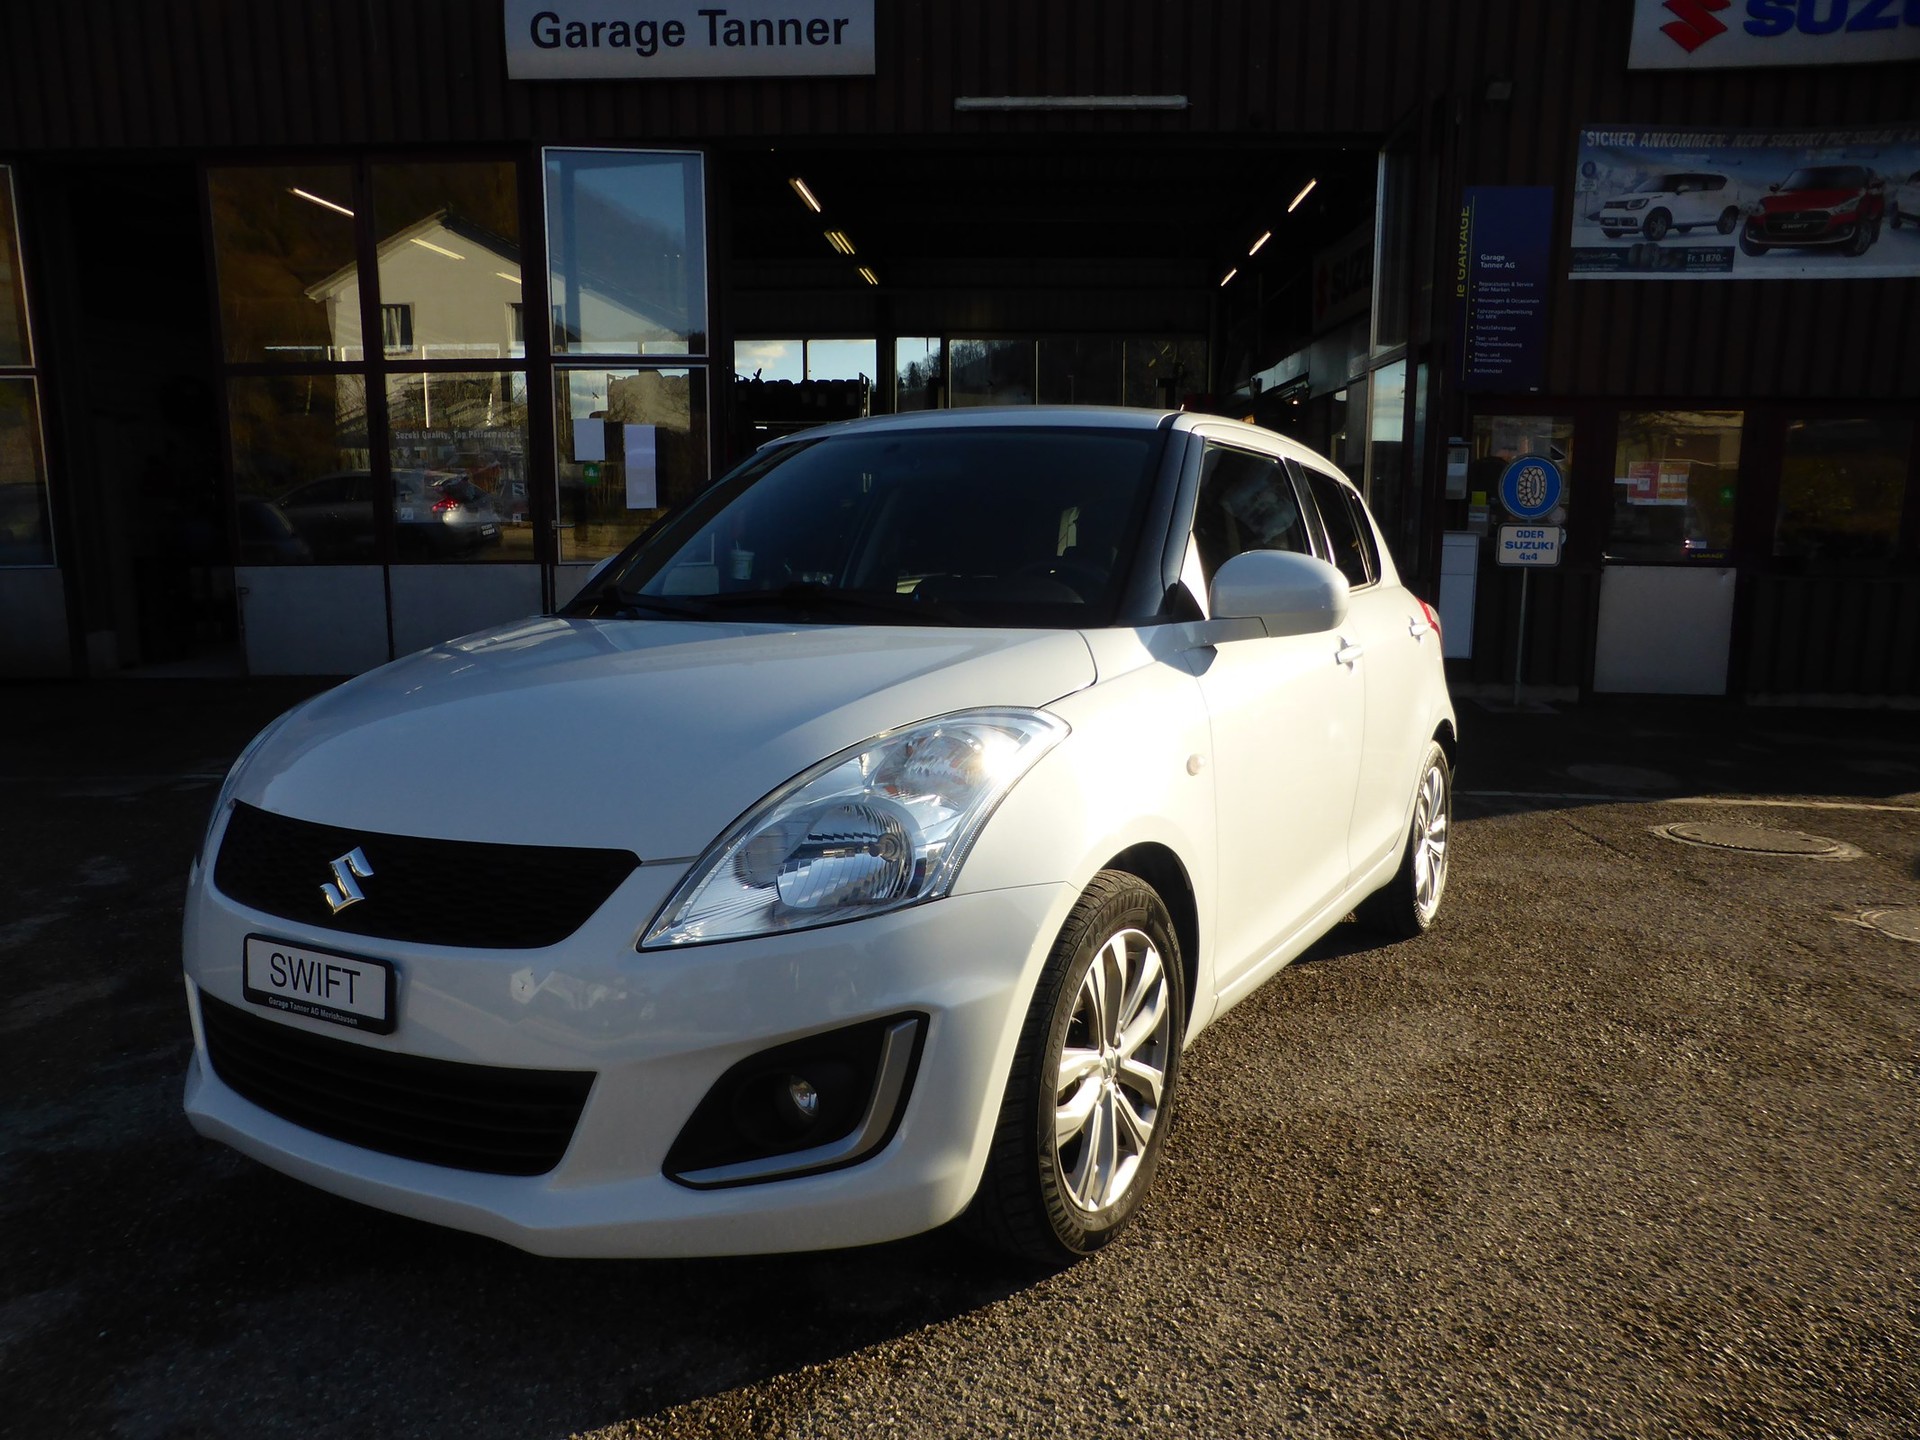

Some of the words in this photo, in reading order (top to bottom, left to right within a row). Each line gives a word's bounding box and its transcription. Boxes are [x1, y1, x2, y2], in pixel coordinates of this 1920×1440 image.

[530, 11, 686, 57] Garage
[698, 9, 849, 47] Tanner
[1586, 131, 1636, 147] SICHER
[1639, 132, 1727, 148] ANKOMMEN:
[1768, 133, 1825, 147] SUZUKI
[1457, 206, 1470, 281] GARAGE
[1480, 253, 1505, 263] Garage
[1687, 253, 1698, 263] Fr.
[395, 430, 420, 441] Suzuki
[1516, 530, 1545, 539] ODER
[1504, 541, 1554, 550] SUZUKI
[1518, 552, 1538, 562] 4x4
[270, 952, 361, 1005] SWIFT
[268, 996, 289, 1010] Garage
[289, 1001, 311, 1014] Tanner
[310, 1007, 320, 1016] AG
